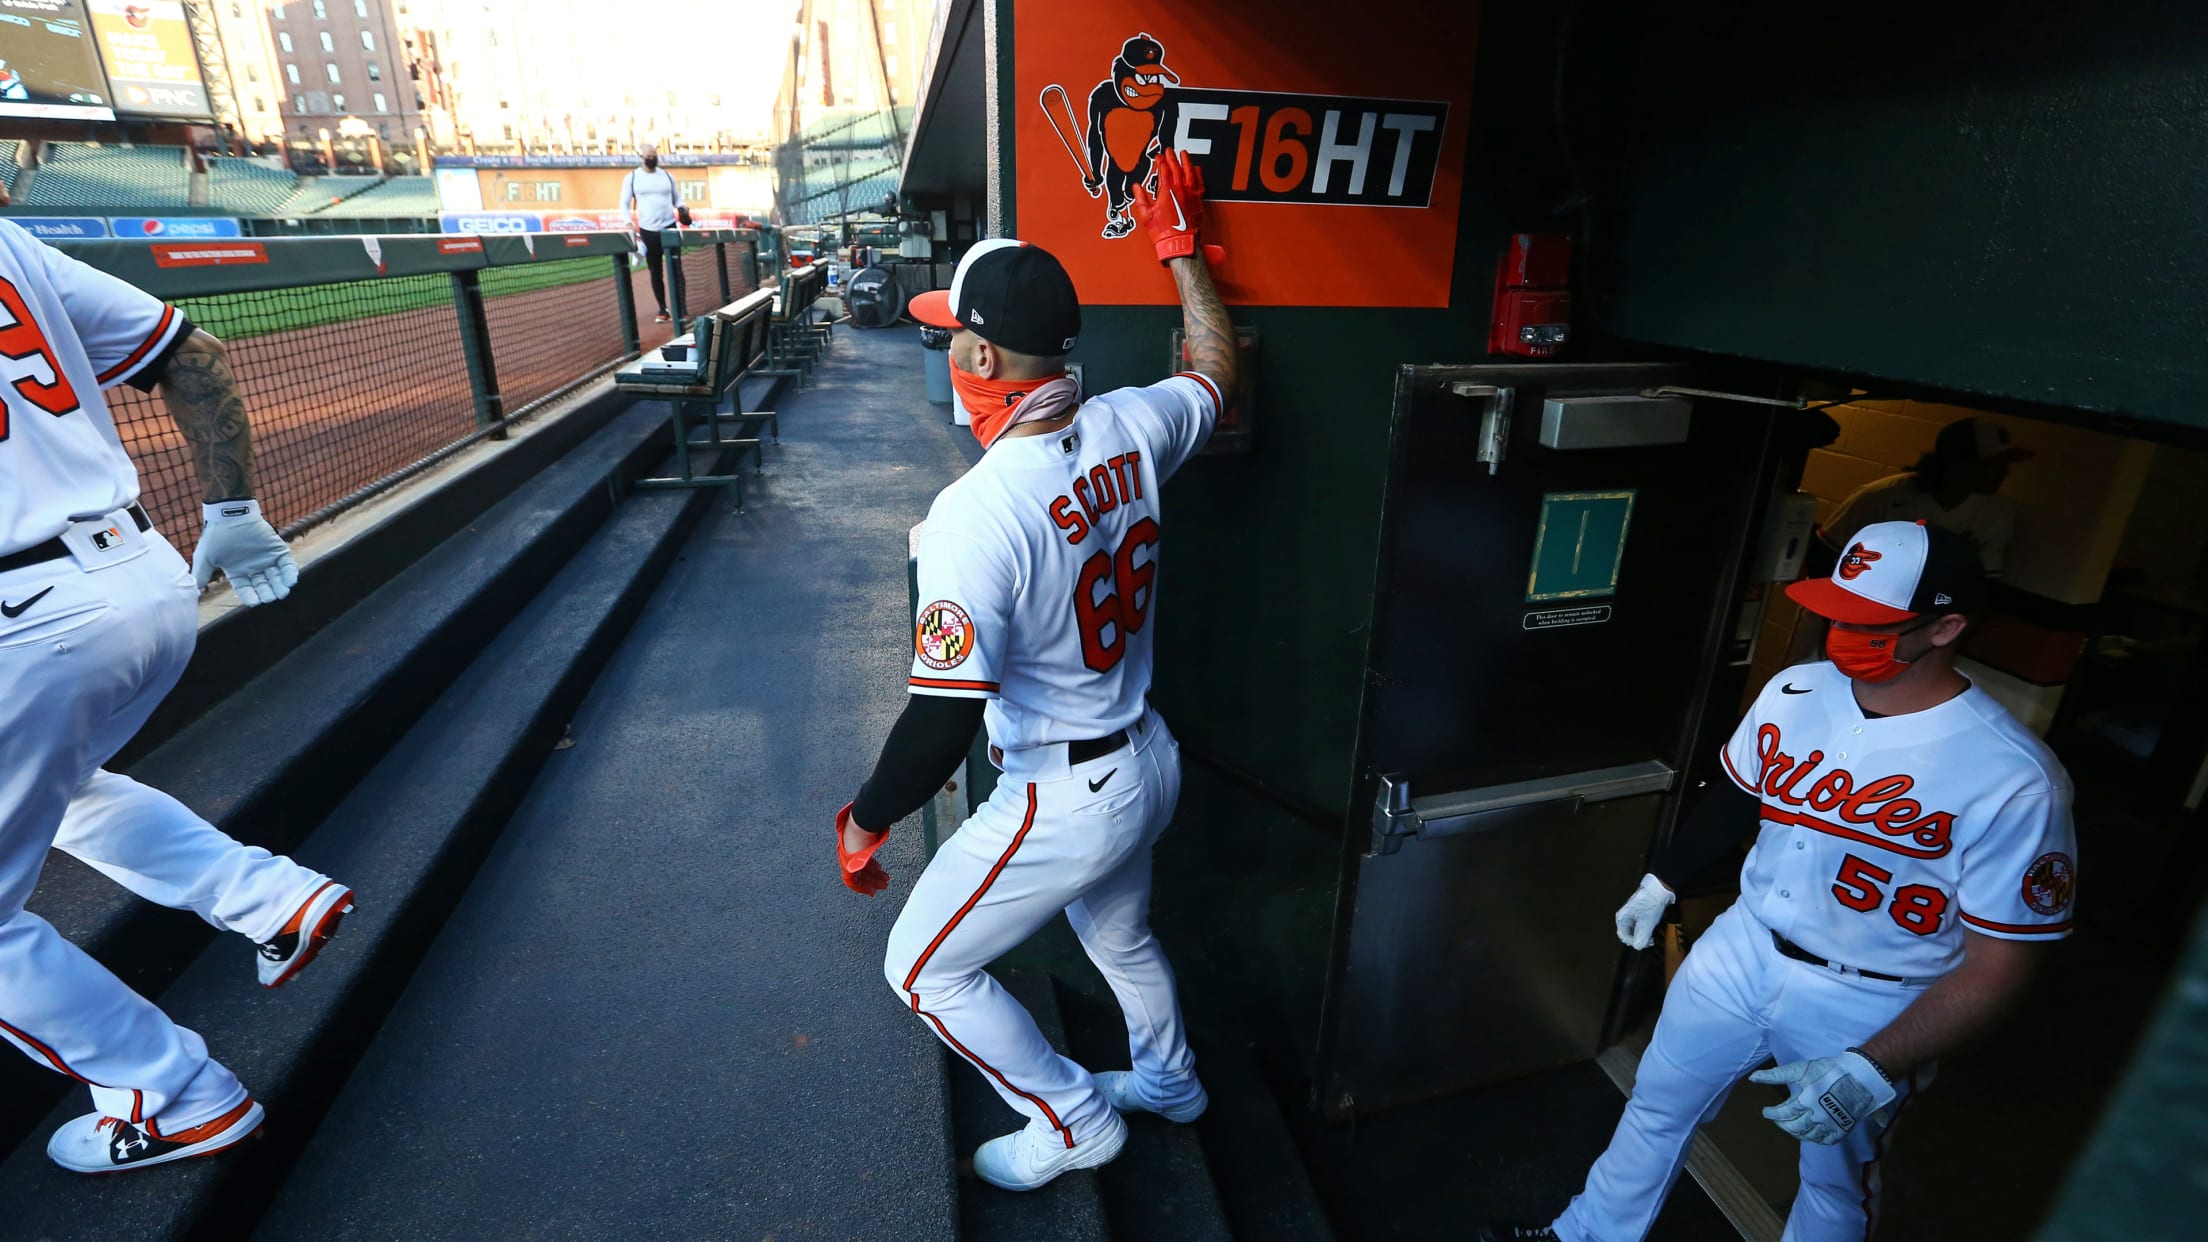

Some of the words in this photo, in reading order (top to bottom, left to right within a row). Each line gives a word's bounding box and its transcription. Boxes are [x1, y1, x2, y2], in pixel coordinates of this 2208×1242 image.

[146, 86, 199, 107] PNC
[168, 220, 217, 236] pepsi
[457, 217, 527, 233] GEICO
[1049, 451, 1143, 545] SCOTT
[1073, 516, 1160, 674] 66
[920, 601, 970, 625] BALTIMORE
[1869, 638, 1887, 649] 58
[920, 653, 965, 669] ORIOLES
[1831, 853, 1949, 937] 58
